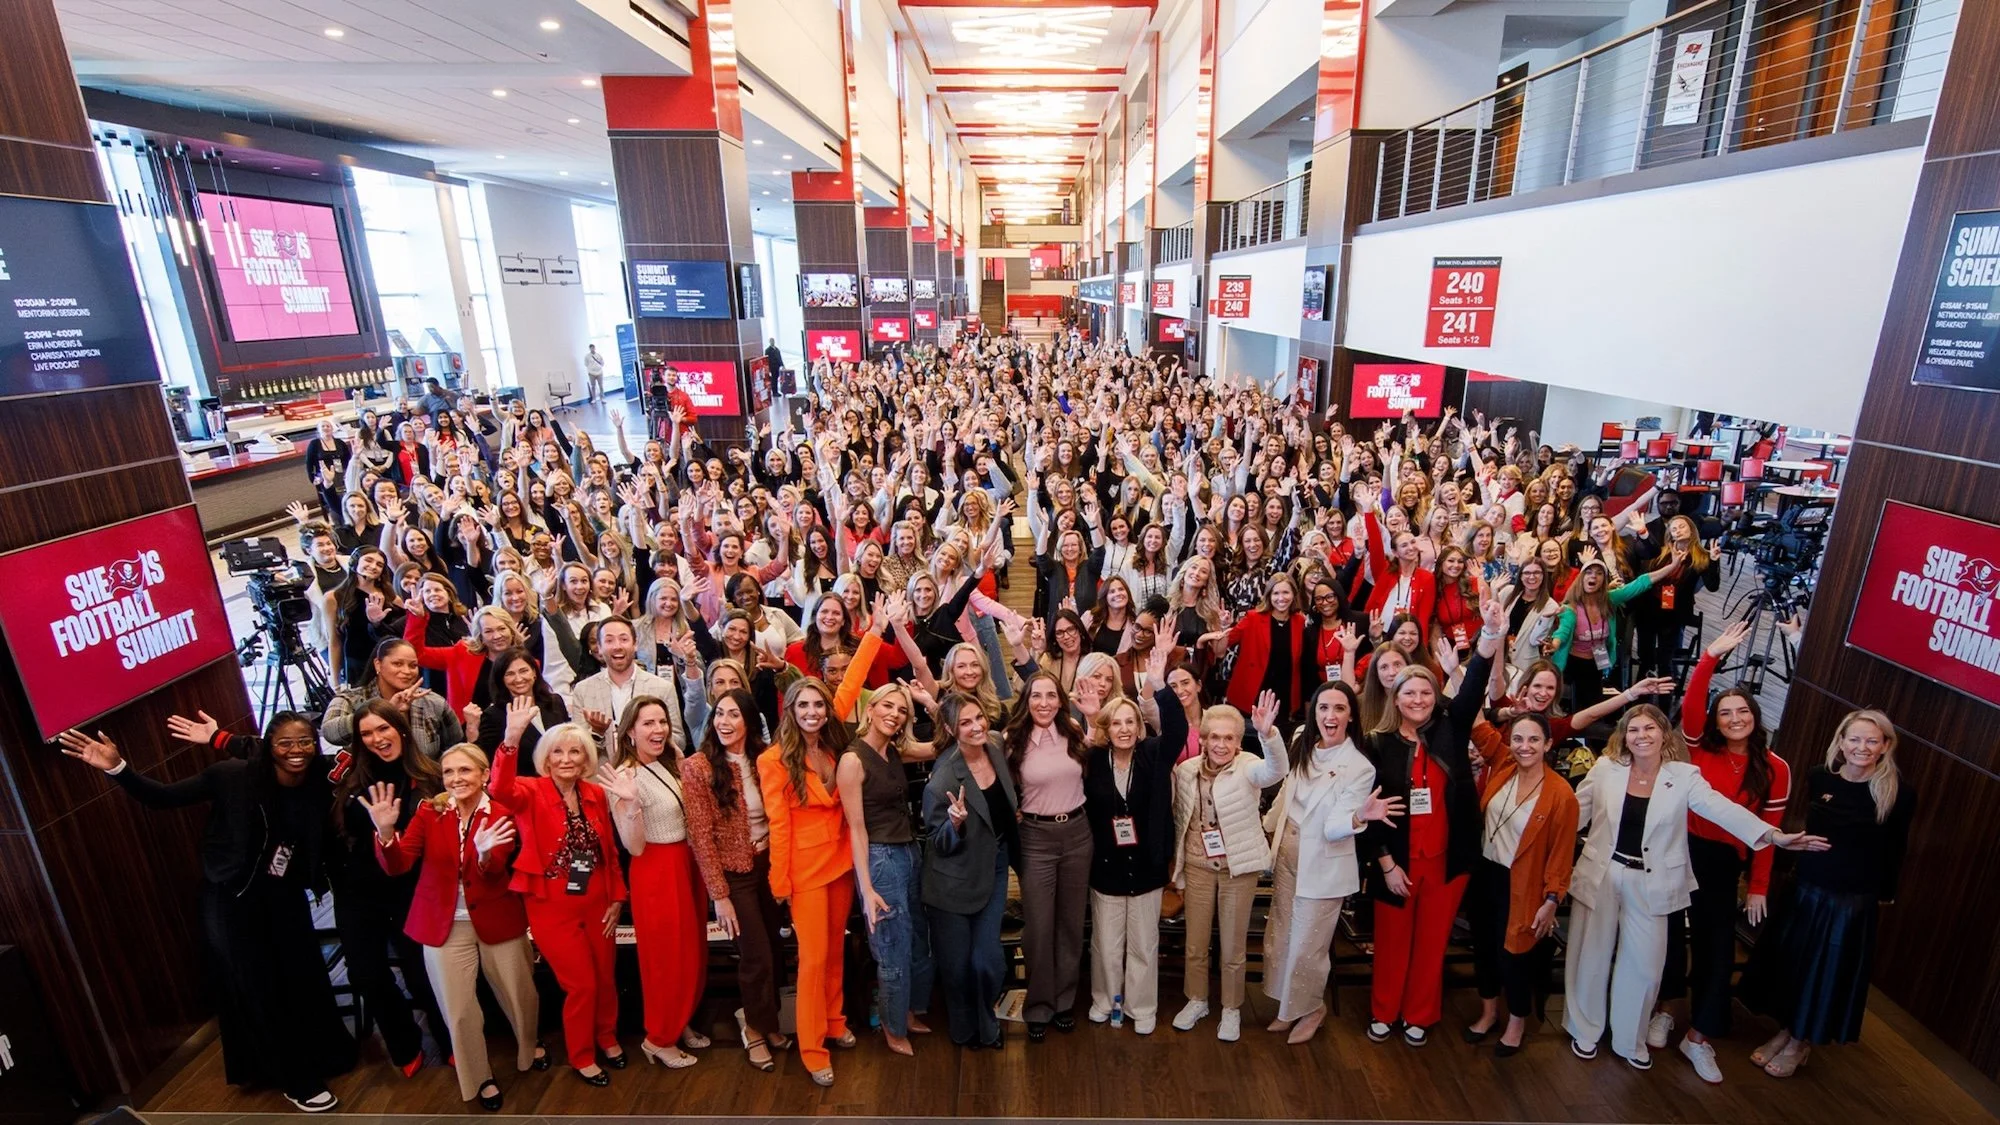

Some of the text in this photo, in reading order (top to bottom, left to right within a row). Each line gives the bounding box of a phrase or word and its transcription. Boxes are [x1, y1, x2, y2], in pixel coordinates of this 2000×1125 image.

[250, 228, 312, 259] SHE IS
[1955, 226, 2000, 256] SUM
[242, 257, 308, 286] FOOTBALL
[636, 264, 669, 275] SUMMIT
[637, 275, 677, 286] SCHEDULE
[1446, 271, 1485, 294] 240
[1226, 281, 1245, 293] 239
[13, 298, 77, 308] 10:30AM 2:00PM
[280, 286, 332, 314] SUMMIT
[1224, 300, 1244, 312] 240
[1439, 296, 1463, 305] Seats
[17, 308, 91, 318] MENTORING SESSIONS
[1937, 311, 1977, 320] NETWORKING
[1442, 311, 1477, 334] 241
[1935, 320, 1969, 329] BREAKFAST
[24, 328, 83, 340] 2:30PM 4:00PM
[1438, 335, 1480, 344] Seats 1-12
[44, 340, 77, 350] ANDREWS
[30, 348, 101, 361] CHARISSA THOMPSON
[1928, 348, 1986, 359] WELCOME REMARKS
[33, 360, 80, 372] LIVE PODCAST
[1930, 357, 1956, 366] OPENING
[1955, 359, 1975, 368] PANEL
[1378, 373, 1421, 387] SHE IS
[1367, 385, 1412, 398] FOOTBALL
[1387, 397, 1427, 409] SUMMIT
[1923, 545, 1968, 586] SHE
[65, 550, 165, 611] SHE IS
[1891, 571, 1993, 633] FOOTBALL
[50, 589, 161, 657] FOOTBALL
[116, 609, 198, 670] SUMMIT
